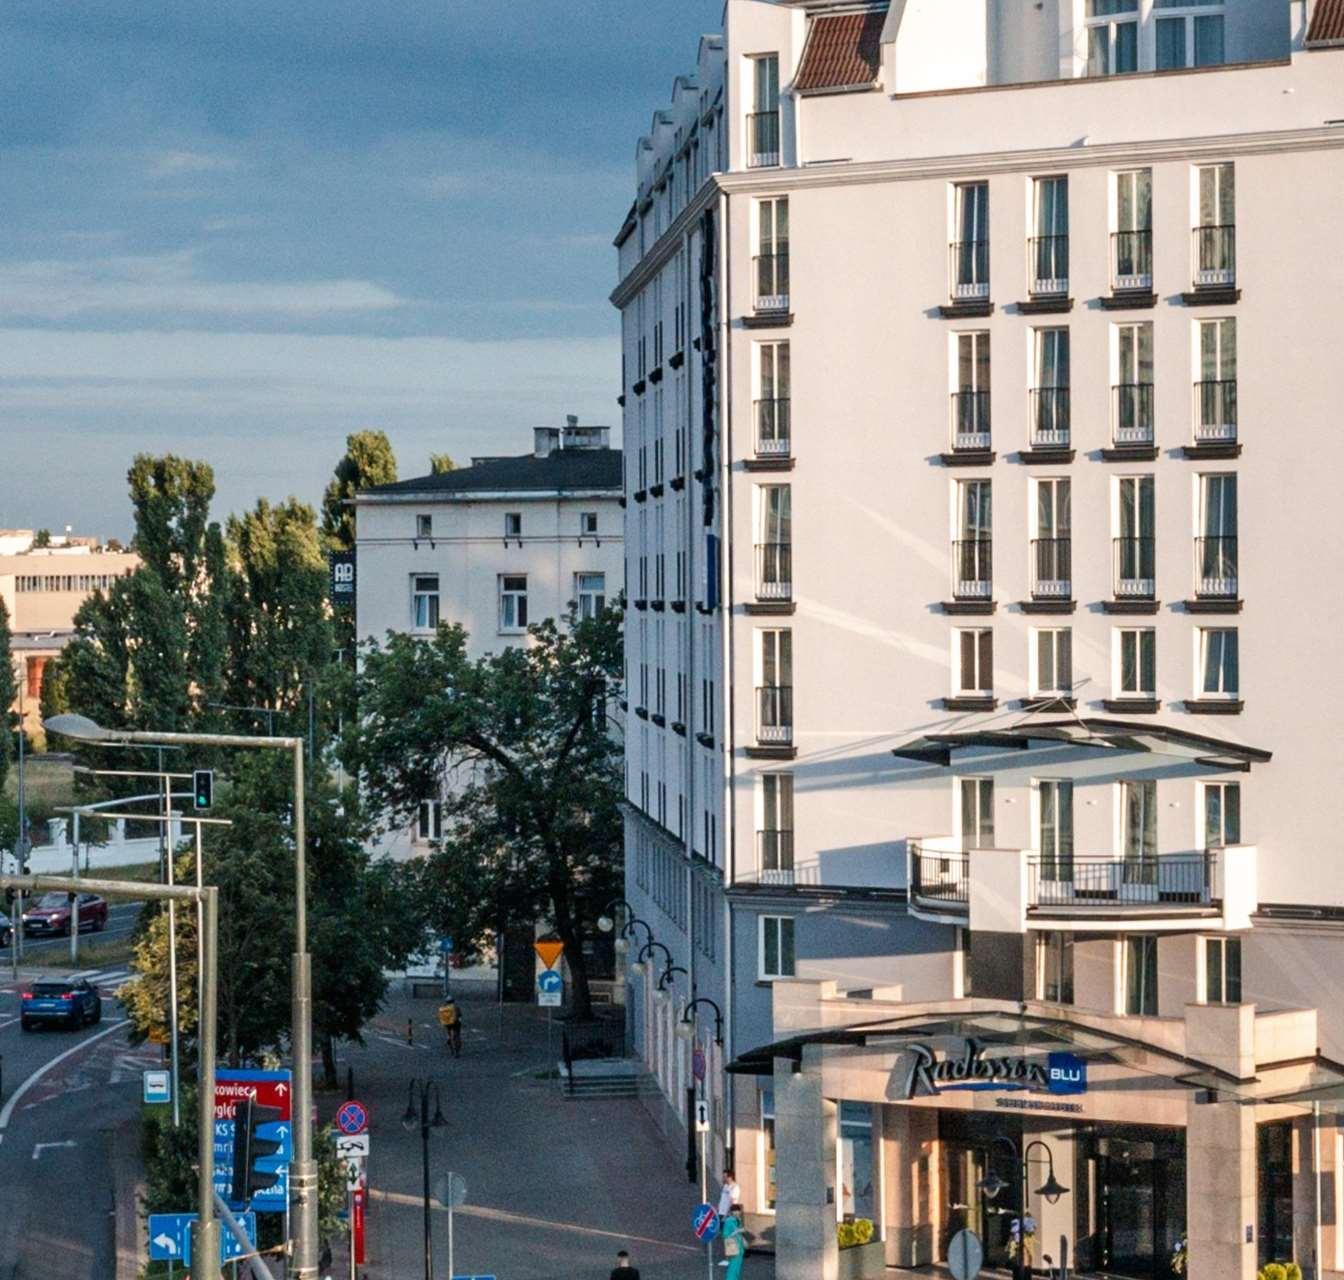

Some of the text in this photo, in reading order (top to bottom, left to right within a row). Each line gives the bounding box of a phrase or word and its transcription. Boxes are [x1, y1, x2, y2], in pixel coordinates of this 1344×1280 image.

[904, 1038, 1081, 1099] Radisson BLU
[214, 1082, 251, 1097] kowiec
